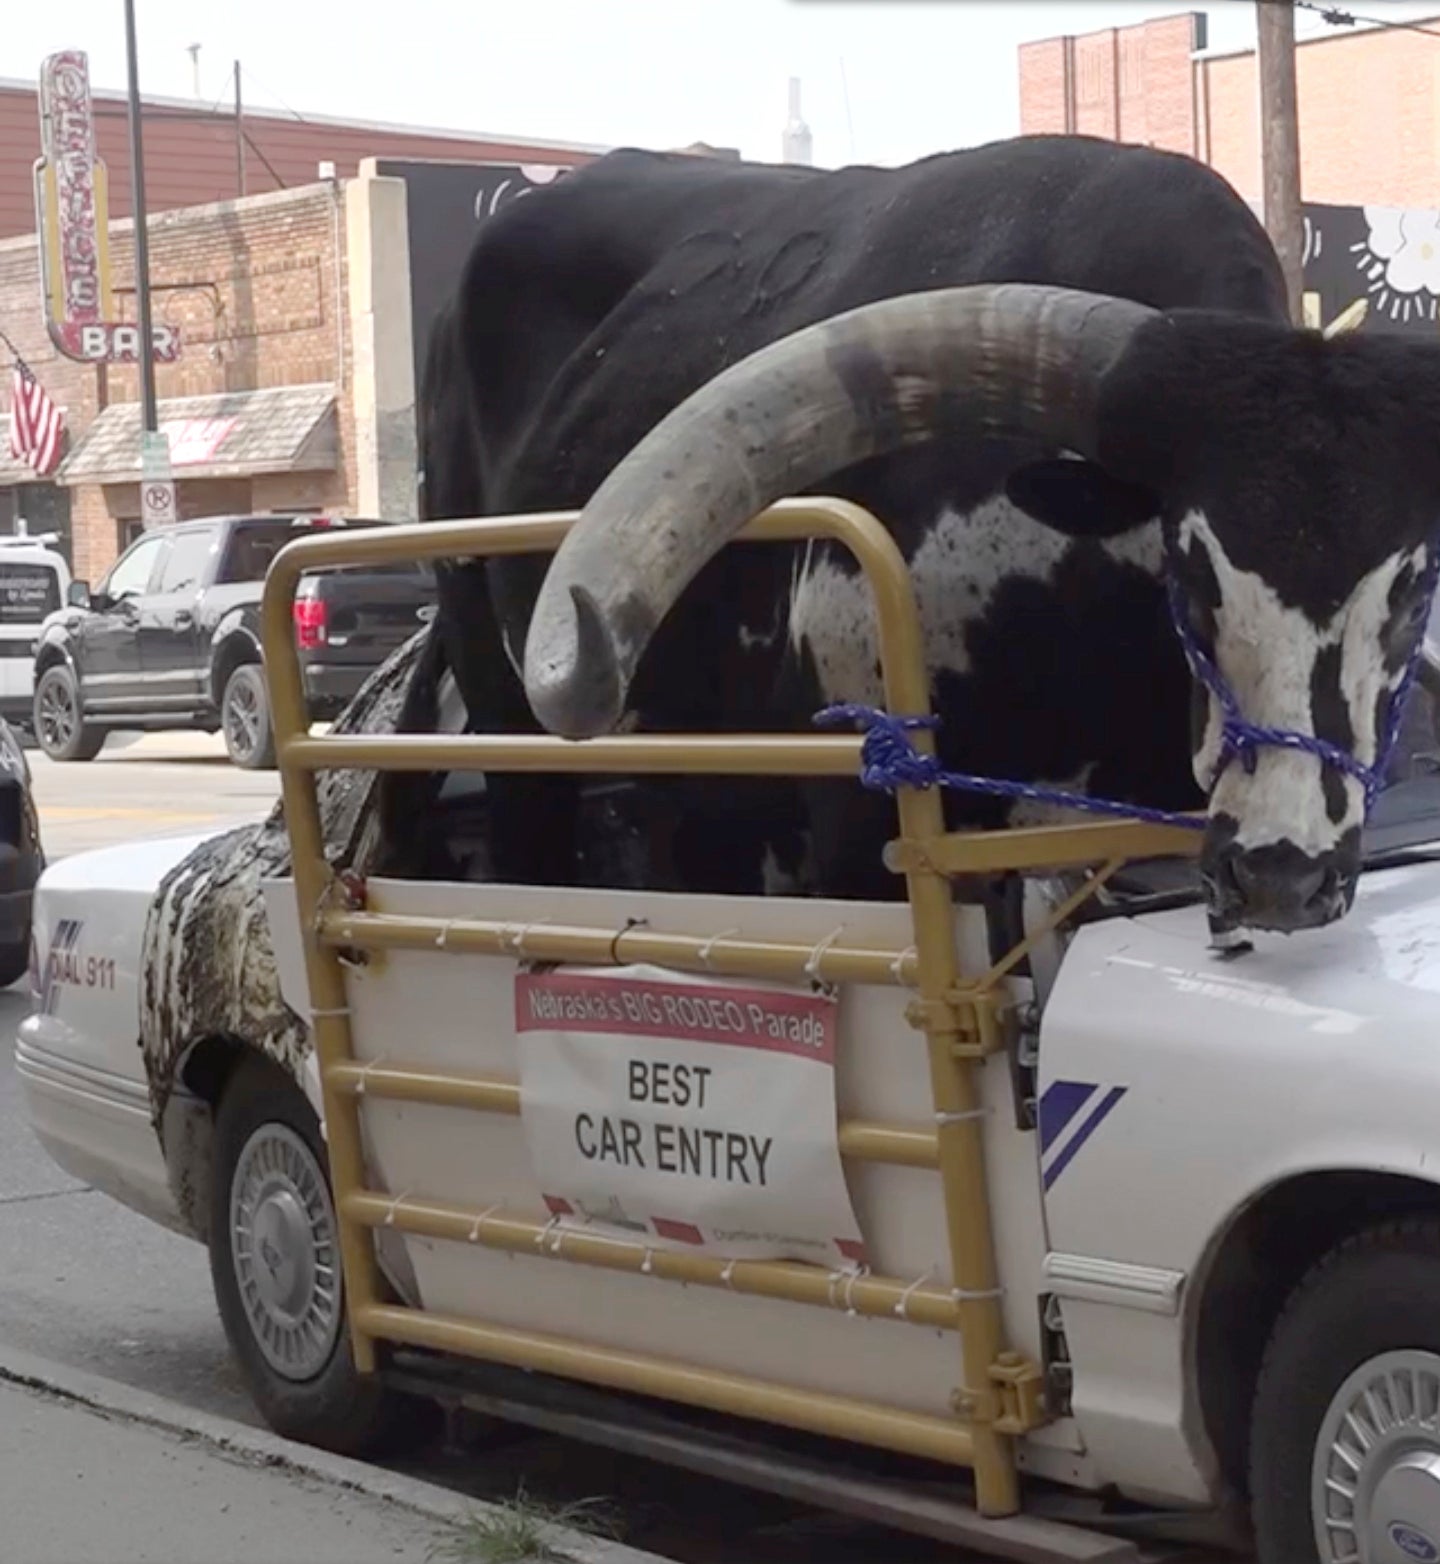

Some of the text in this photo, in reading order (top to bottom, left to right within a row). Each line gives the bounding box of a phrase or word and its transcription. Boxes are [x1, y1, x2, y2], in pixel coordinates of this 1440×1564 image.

[82, 326, 172, 358] BAR
[87, 956, 116, 990] 911
[528, 988, 825, 1049] Nebraska's BIG RODEO Parade
[628, 1059, 712, 1109] BEST
[574, 1112, 773, 1187] CAR ENTRY
